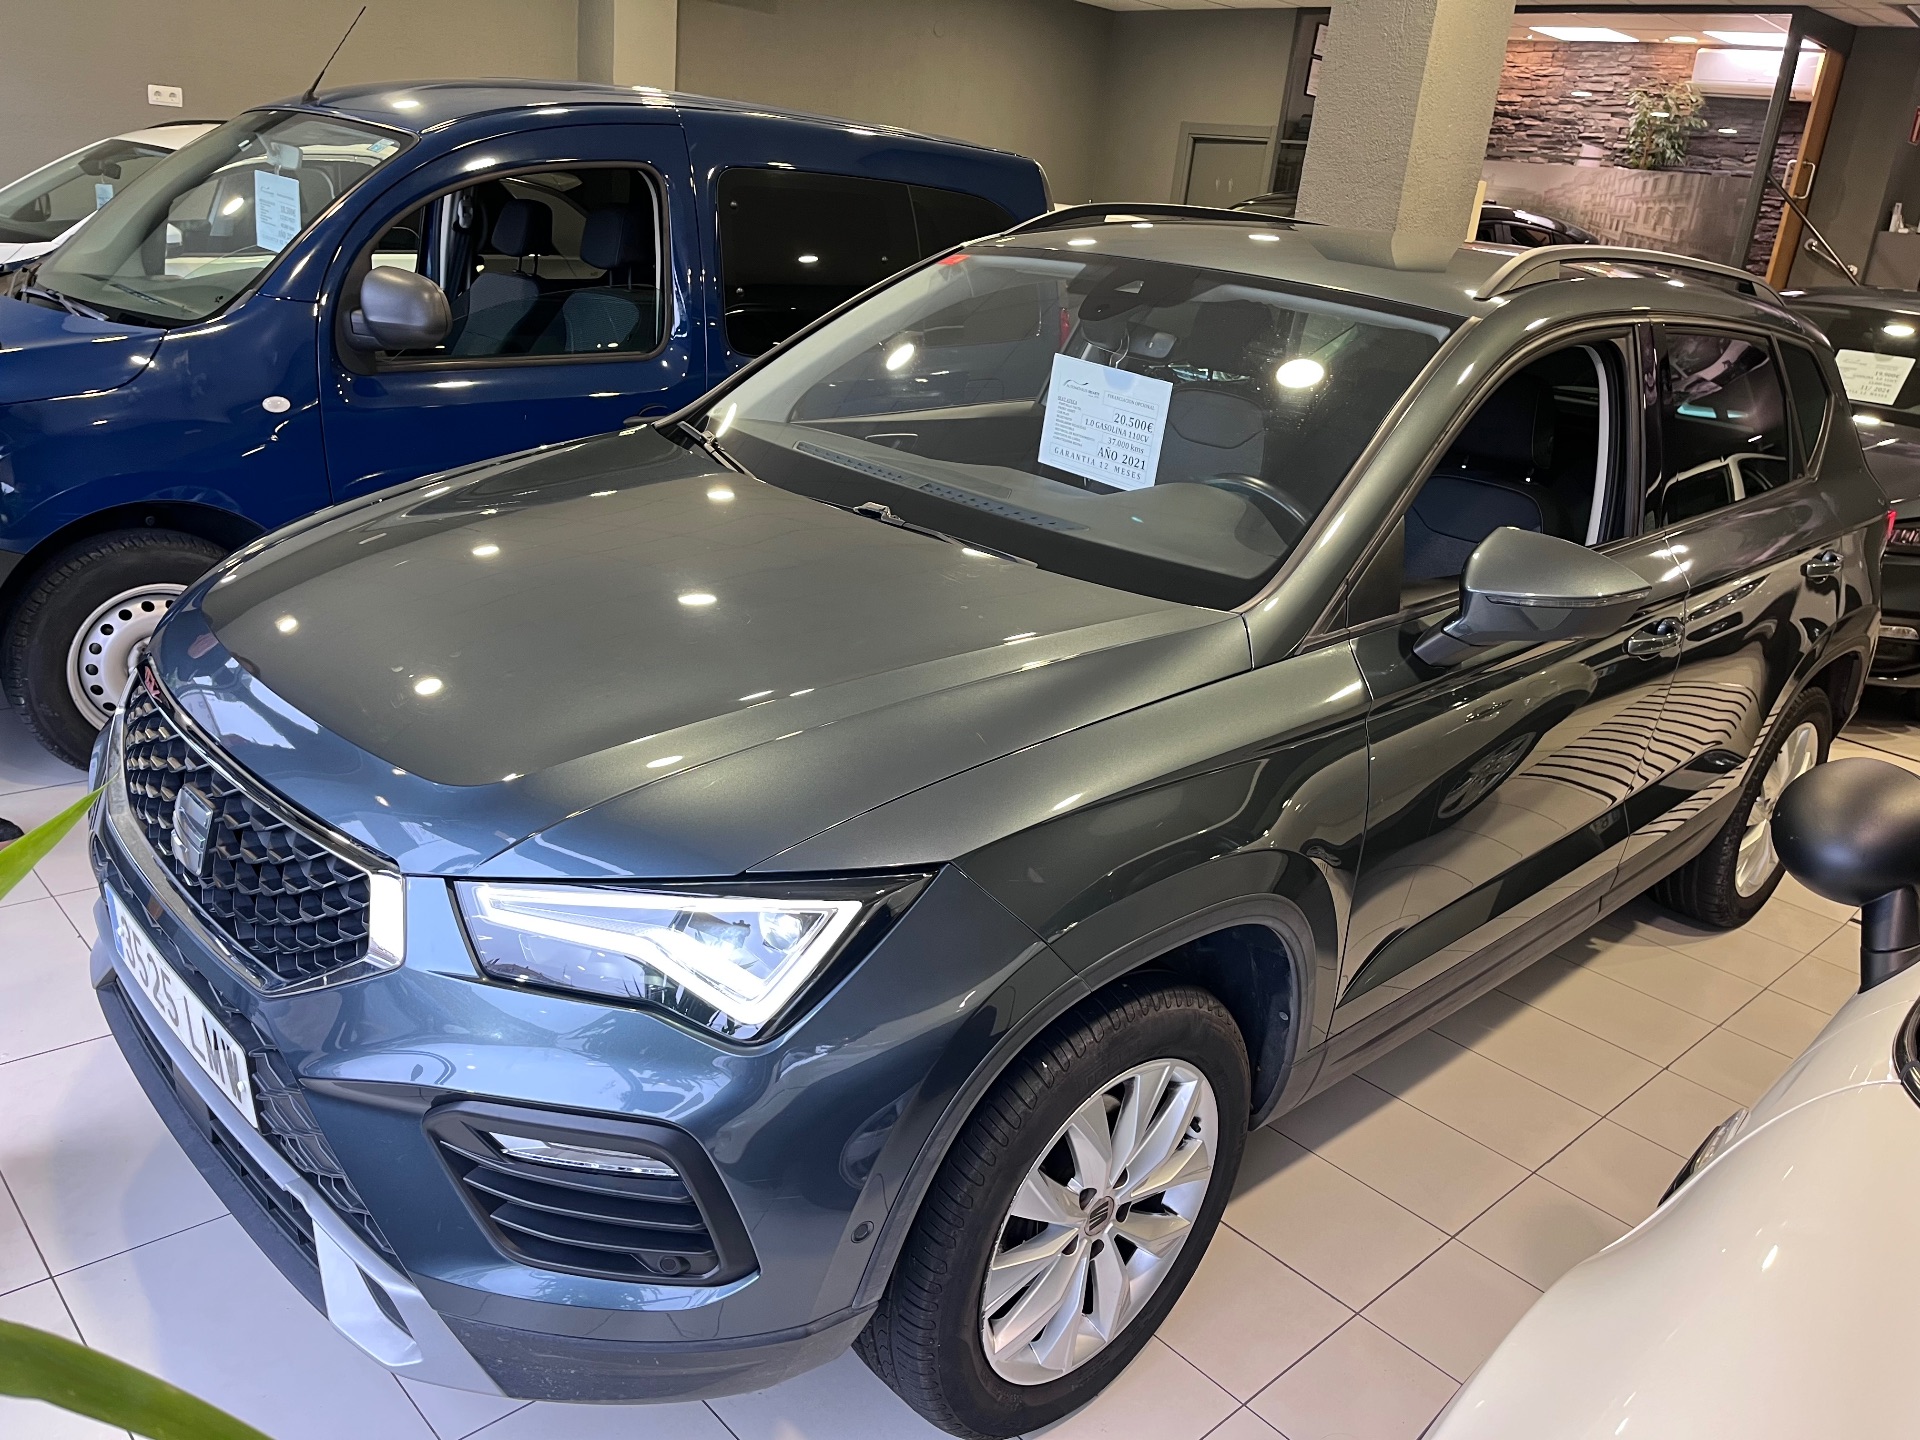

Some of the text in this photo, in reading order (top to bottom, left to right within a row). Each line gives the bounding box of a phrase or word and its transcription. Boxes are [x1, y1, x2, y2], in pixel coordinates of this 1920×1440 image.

[1085, 418, 1095, 426] 1.0
[1095, 421, 1127, 436] GASOLINA
[1128, 430, 1150, 443] 110CV
[1113, 413, 1154, 433] 20.500€
[1108, 436, 1144, 454] 37.000 kms
[1054, 447, 1141, 480] GARANTIA 12 MESES
[1097, 446, 1145, 470] AÑO 2021
[120, 915, 180, 1027] 3525
